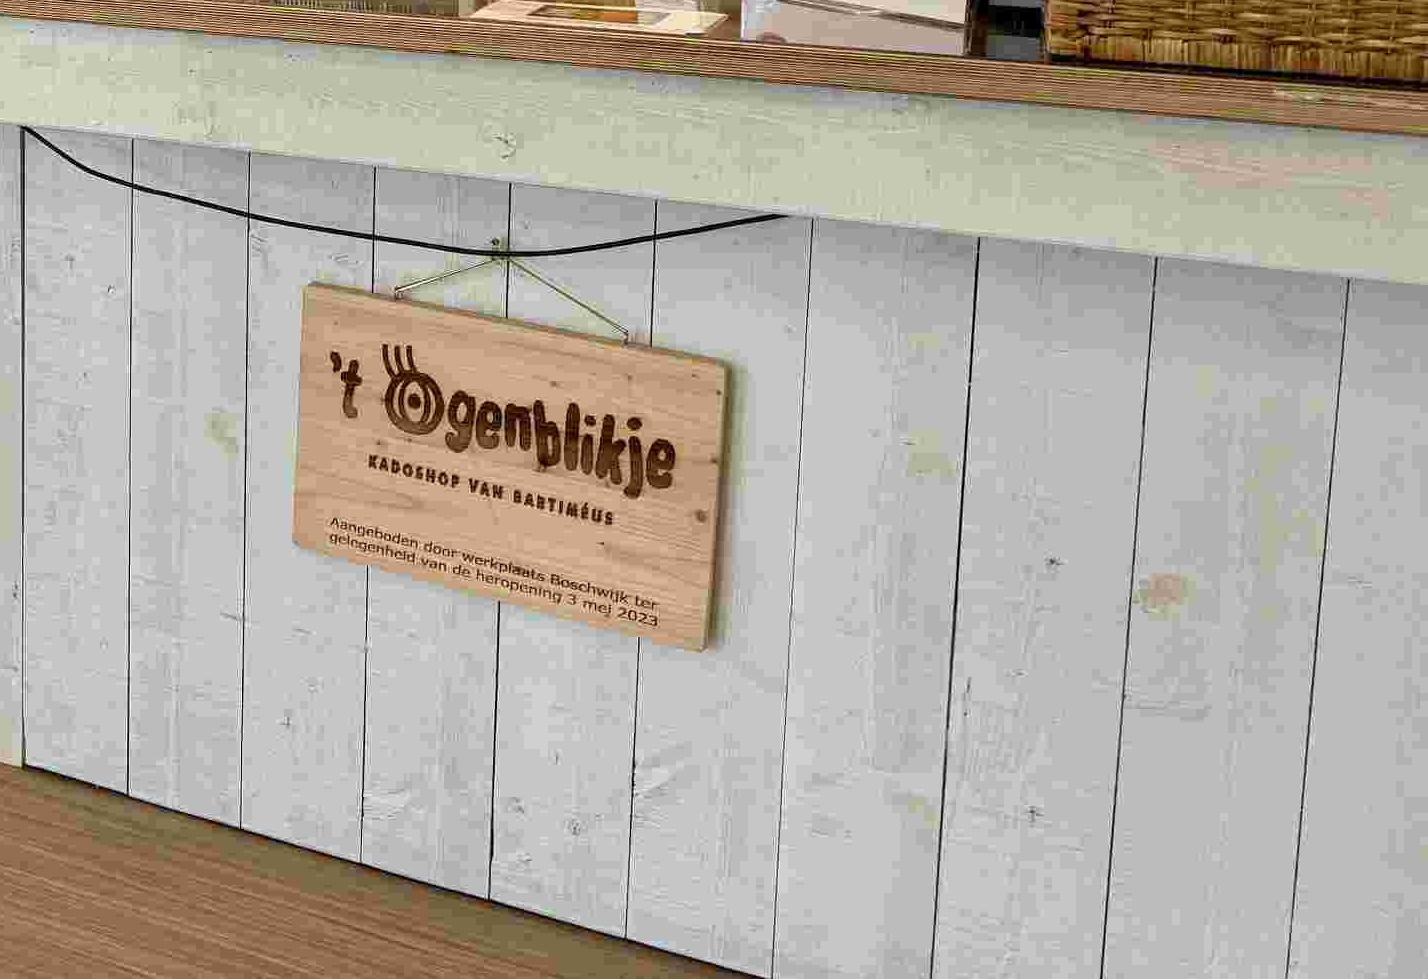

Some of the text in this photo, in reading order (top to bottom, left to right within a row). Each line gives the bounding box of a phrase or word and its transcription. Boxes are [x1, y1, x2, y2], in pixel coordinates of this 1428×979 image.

[368, 454, 613, 525] KADOSHOP VAN BARTIMÉUS
[329, 533, 416, 564] gelegenheid
[421, 558, 447, 572] van
[453, 564, 471, 577] de
[476, 568, 563, 605] heropening
[568, 593, 577, 605] 3
[617, 606, 659, 627] 2023
[330, 517, 419, 548] Aangeboden
[423, 541, 460, 558] door
[461, 552, 546, 582] werkplaats
[635, 595, 660, 611] ter
